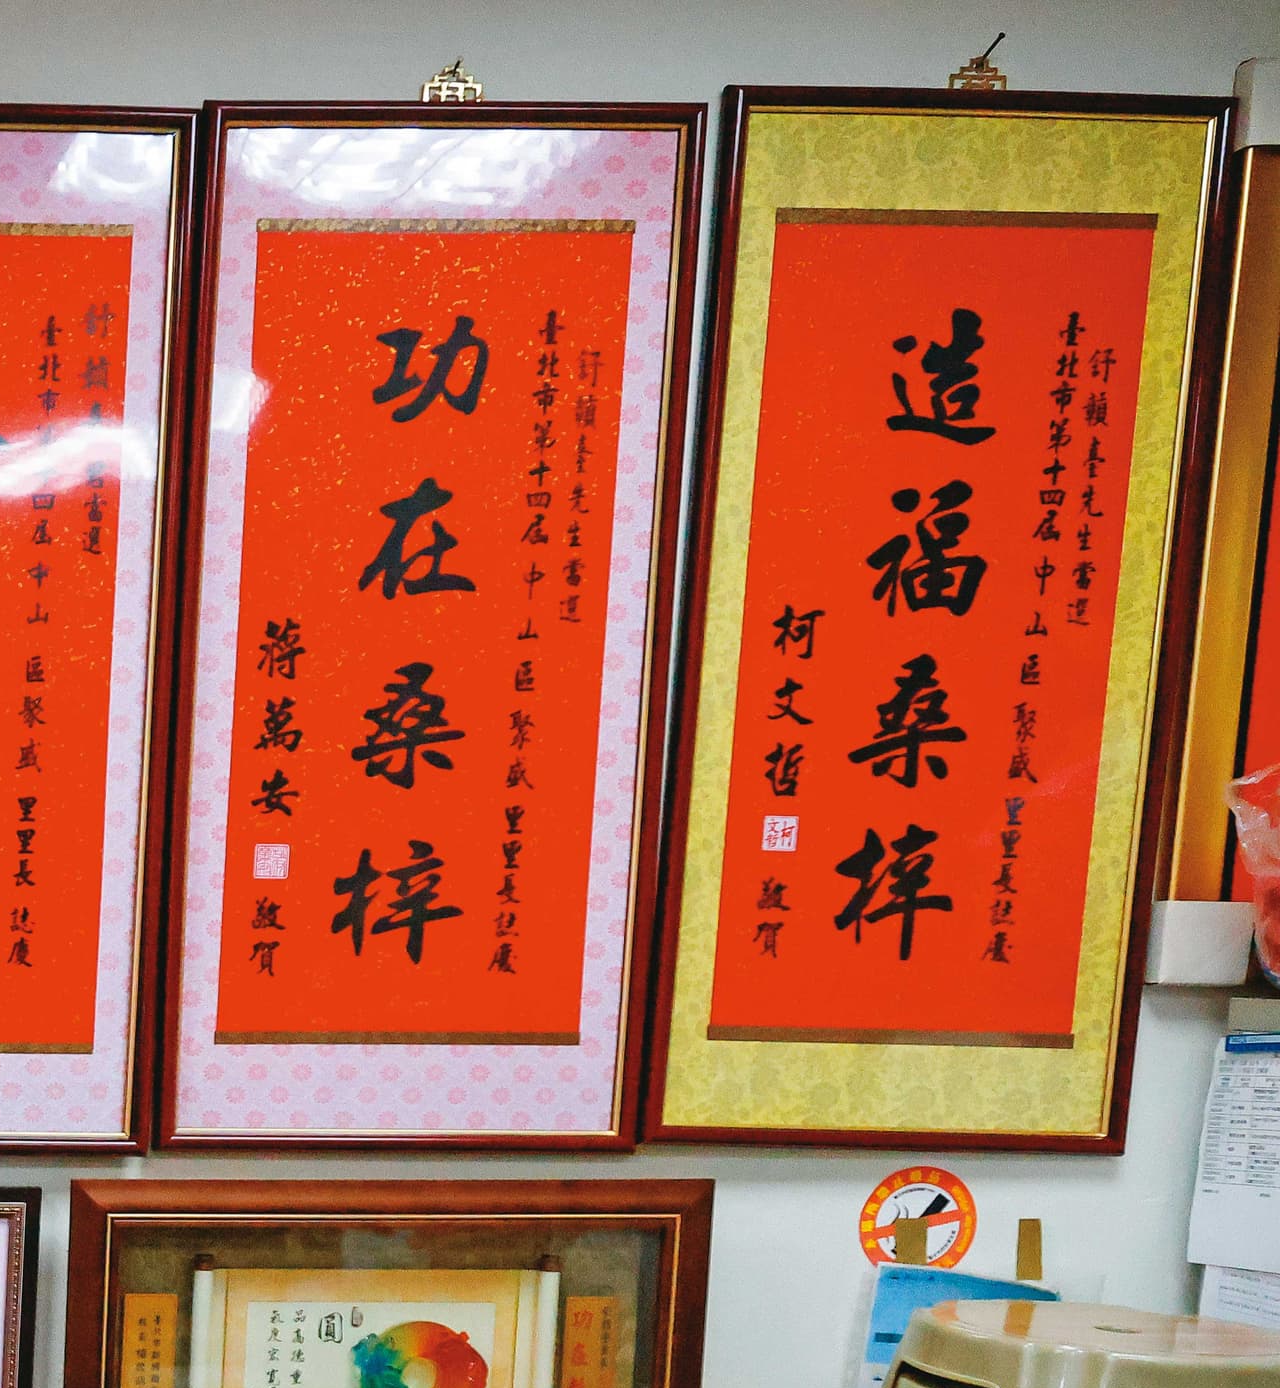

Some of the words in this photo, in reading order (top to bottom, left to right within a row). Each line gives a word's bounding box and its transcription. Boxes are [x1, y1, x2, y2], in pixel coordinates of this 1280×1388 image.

[251, 618, 307, 817] 蔣萬安
[331, 314, 490, 965] 功在桑梓
[764, 604, 825, 797] 柯文哲
[834, 307, 997, 961] 造福桑梓
[248, 896, 287, 978] 敬賀
